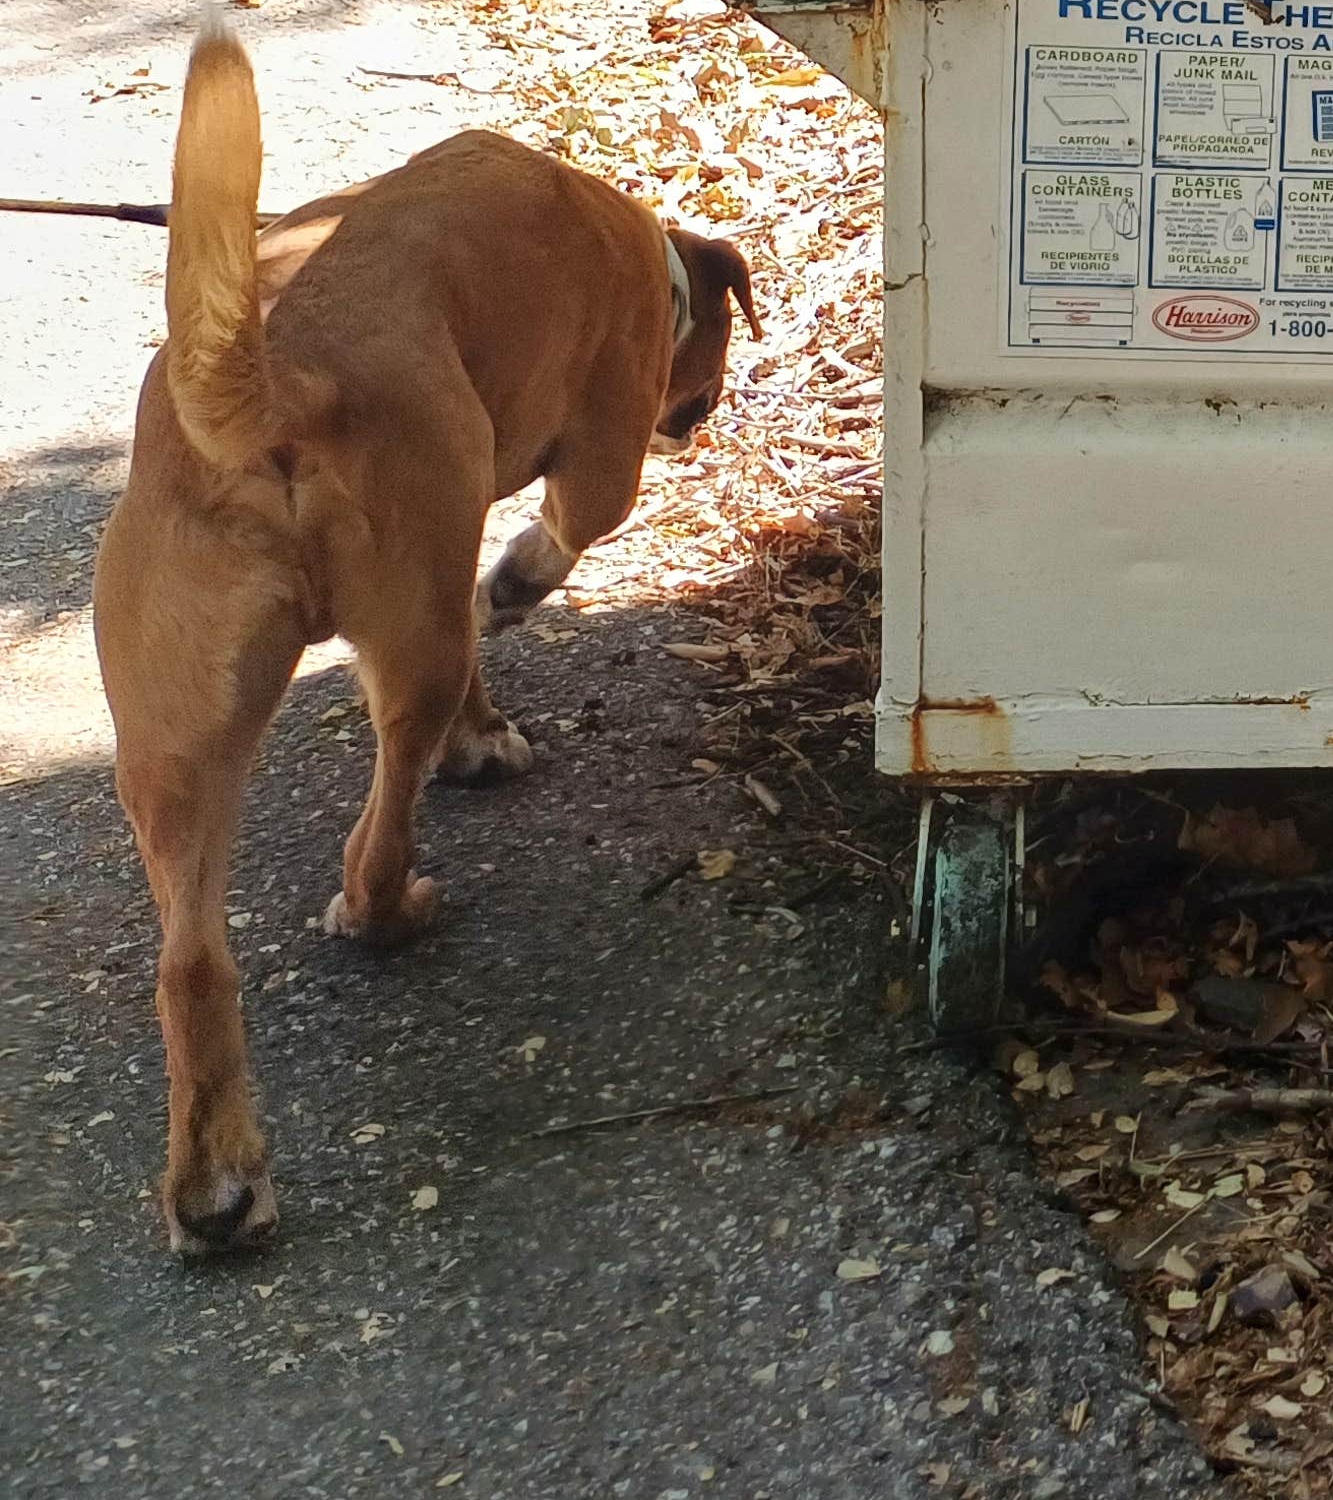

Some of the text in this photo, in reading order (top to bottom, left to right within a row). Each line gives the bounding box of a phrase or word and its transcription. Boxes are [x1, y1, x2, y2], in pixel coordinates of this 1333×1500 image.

[1037, 50, 1138, 63] CARDBOARD
[1189, 56, 1245, 67] PAPER/
[1174, 68, 1258, 81] JUNK MAIL
[1254, 138, 1268, 146] DE
[1173, 144, 1254, 154] PROPAGANDA
[1057, 175, 1110, 186] GLASS
[1176, 177, 1240, 187] PLASTIC
[1032, 185, 1133, 198] CONTAINERS
[1172, 188, 1242, 199] BOTTLES
[1041, 252, 1119, 261] RECIPIENTES
[1168, 255, 1248, 265] BOTELLAS DE
[1050, 261, 1110, 271] DE VIDRIO
[1305, 265, 1323, 274] DE
[1259, 298, 1276, 306] For
[1280, 299, 1327, 310] recycling
[1165, 306, 1252, 327] Harrison
